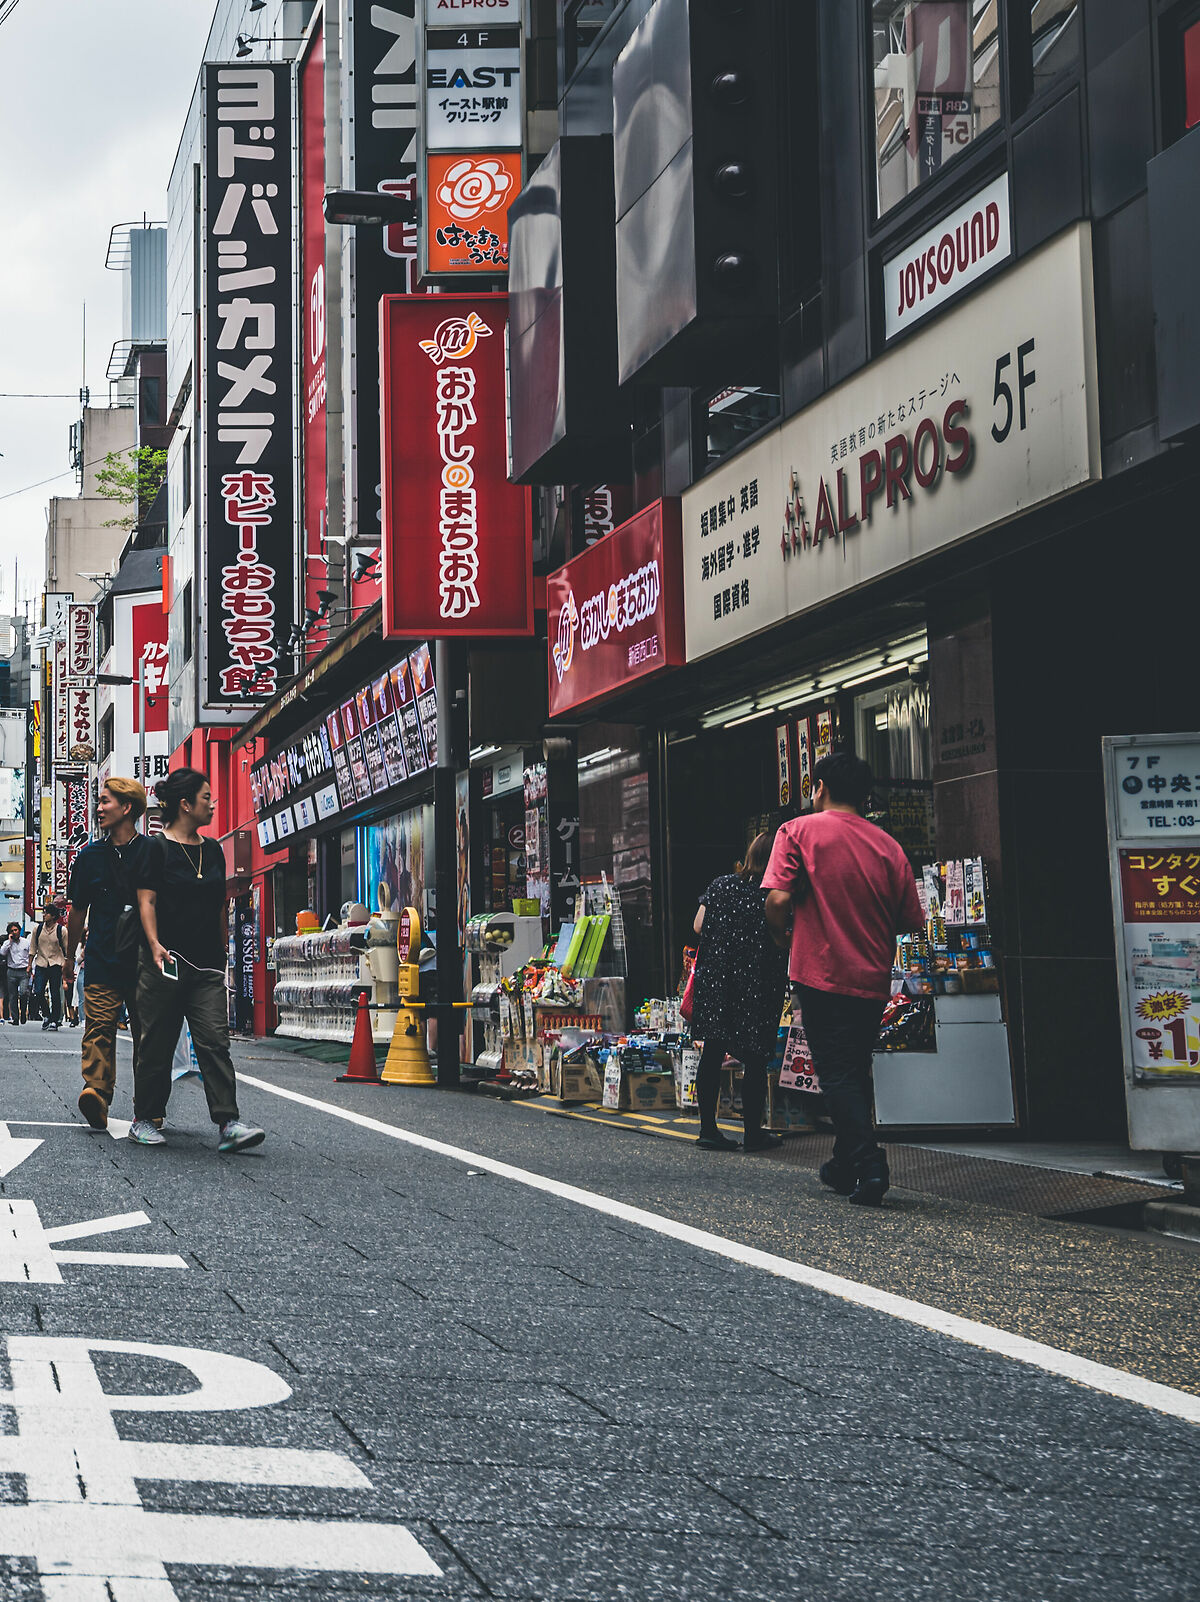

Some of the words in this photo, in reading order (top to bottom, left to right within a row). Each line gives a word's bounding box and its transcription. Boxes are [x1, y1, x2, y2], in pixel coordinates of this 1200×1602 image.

[437, 0, 509, 9] ALPROS
[427, 67, 520, 89] EAST
[438, 97, 509, 110] イースト駅前
[446, 111, 502, 123] クリニック
[436, 222, 500, 248] はなまる
[469, 247, 510, 265] うどん
[897, 201, 1000, 317] JOYSOUND
[212, 68, 280, 466] ヨドバシカメラ
[990, 337, 1036, 444] 5F
[830, 371, 962, 466] 英語教育の新たなステージへ
[436, 366, 481, 619] おかしのまちおか
[813, 399, 972, 548] ALPROS
[701, 524, 761, 583] 海外留学・進学
[581, 559, 660, 651] おかしのまちおか
[713, 577, 750, 621] 国際資格
[73, 609, 92, 672] カラオケ
[1127, 756, 1160, 770] 7F
[242, 938, 254, 973] BOSS
